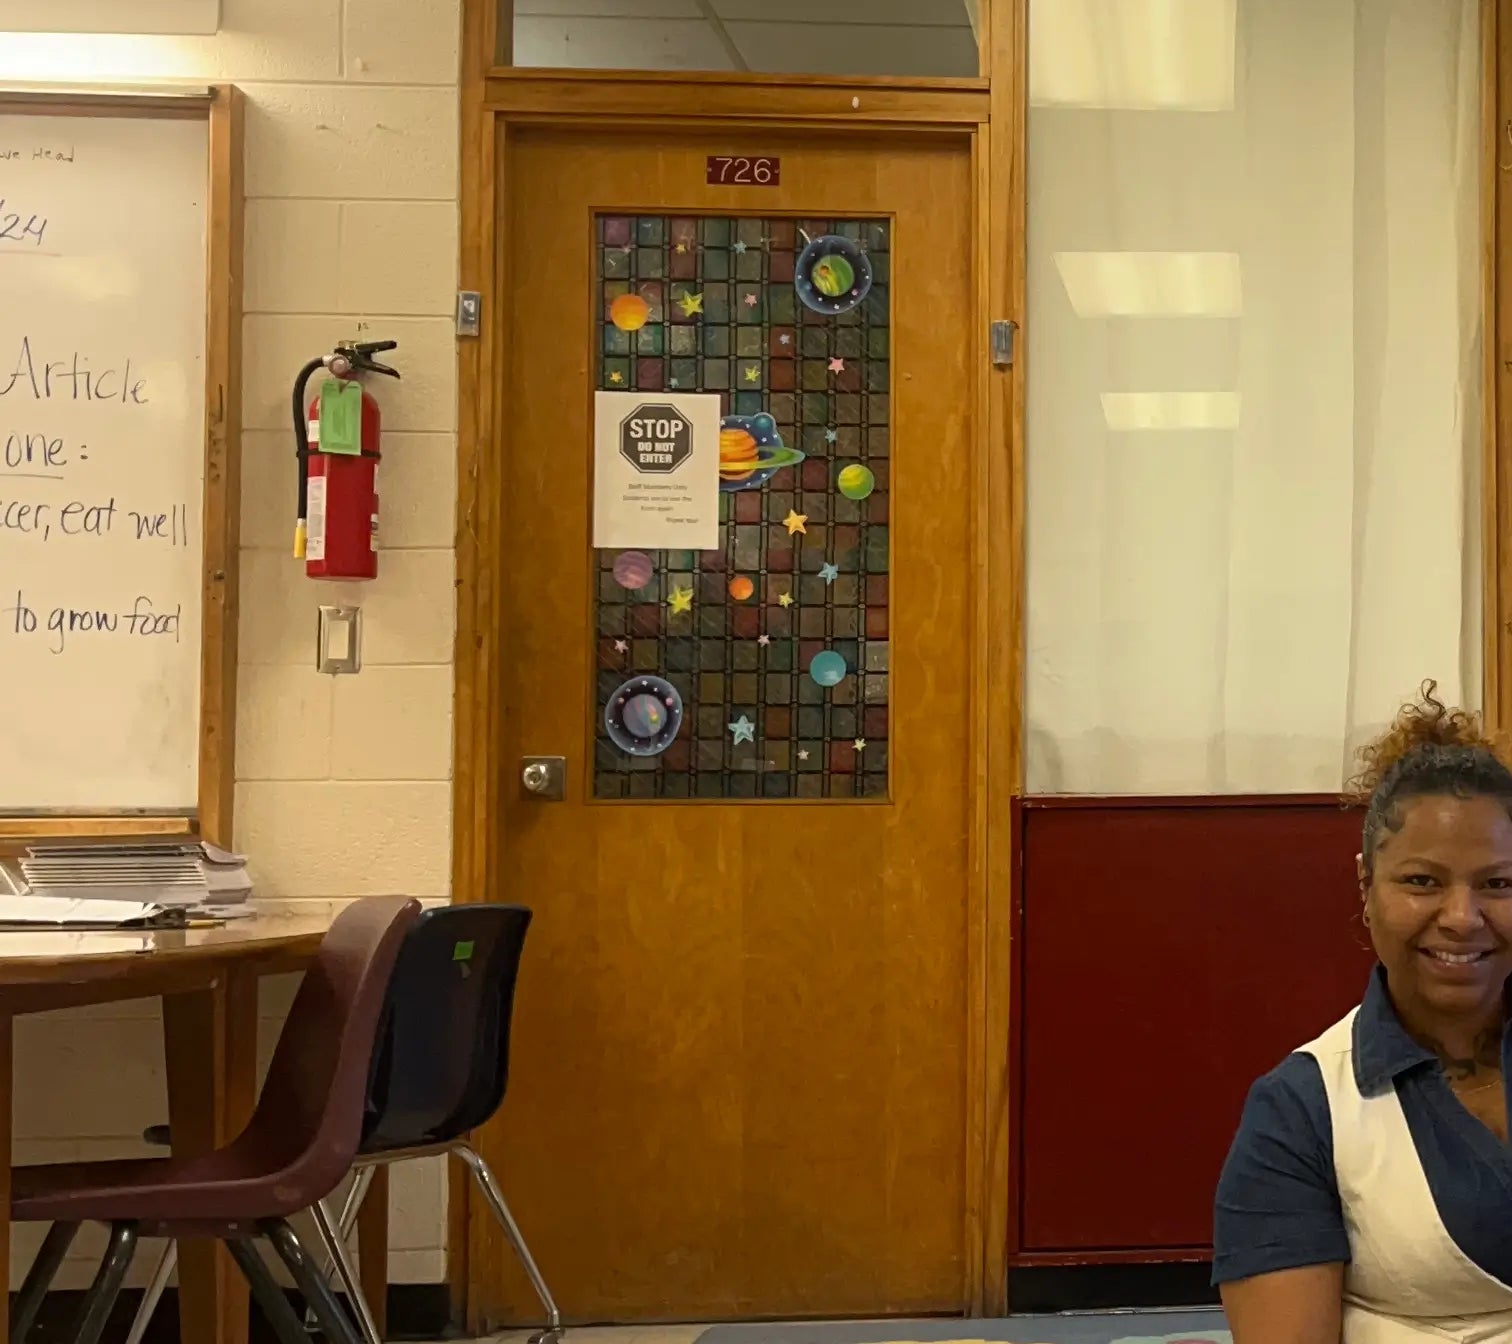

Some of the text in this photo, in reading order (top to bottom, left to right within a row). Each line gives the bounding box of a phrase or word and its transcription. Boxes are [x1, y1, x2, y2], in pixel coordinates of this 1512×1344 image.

[716, 157, 771, 183] 726
[0, 336, 149, 404] Article
[629, 419, 683, 439] STOP
[638, 442, 675, 452] DO NOT
[640, 454, 673, 464] ENTER
[0, 497, 187, 547] cer, eat well
[3, 589, 181, 655] to grow food
